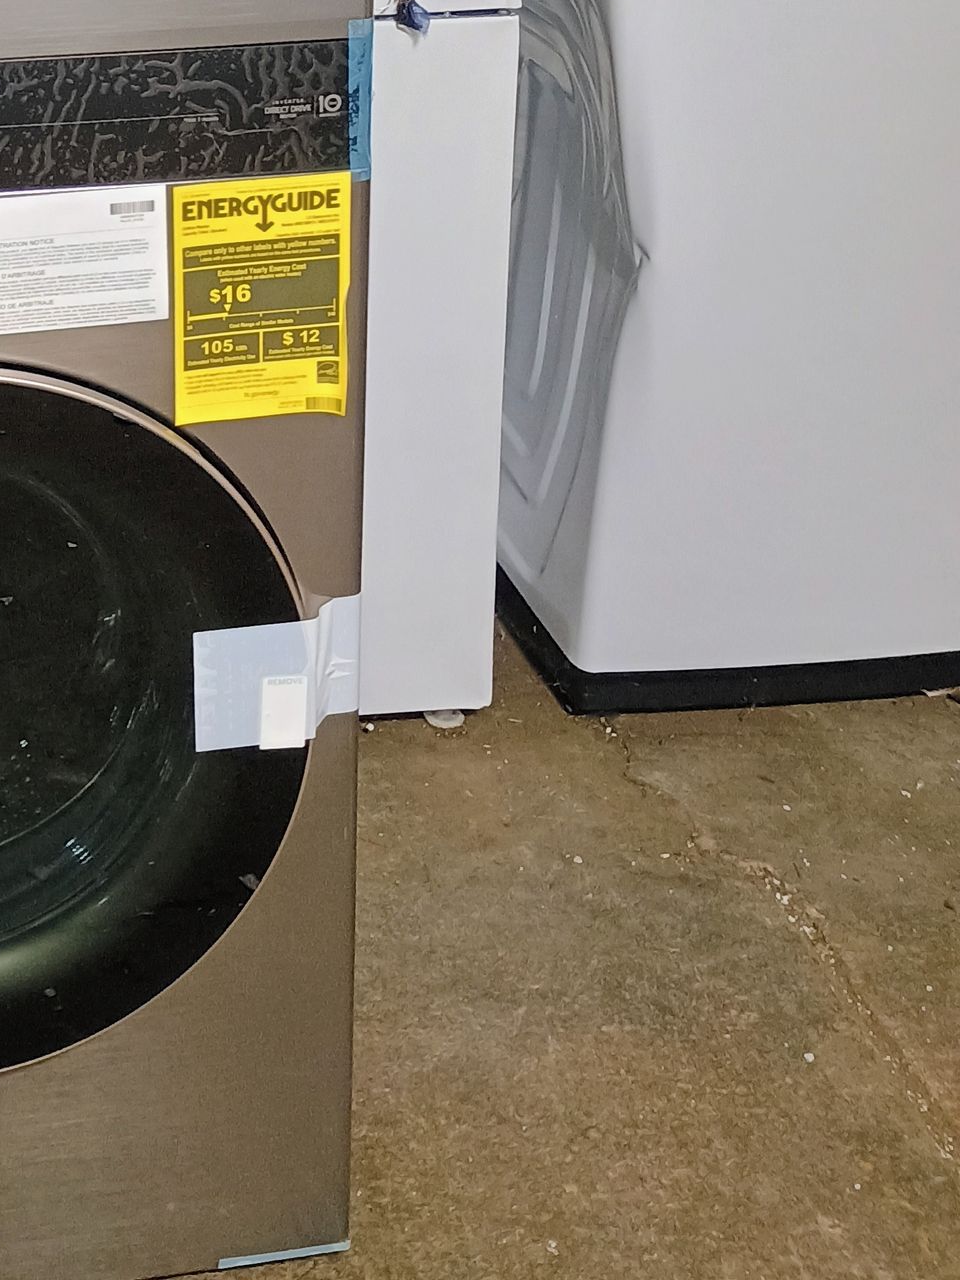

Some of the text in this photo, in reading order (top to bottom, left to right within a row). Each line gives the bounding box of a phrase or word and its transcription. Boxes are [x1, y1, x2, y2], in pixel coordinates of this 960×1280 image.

[182, 188, 340, 222] ENERGYGUIDE
[209, 283, 252, 304] $16
[201, 338, 233, 355] 105
[283, 329, 320, 346] $ 12
